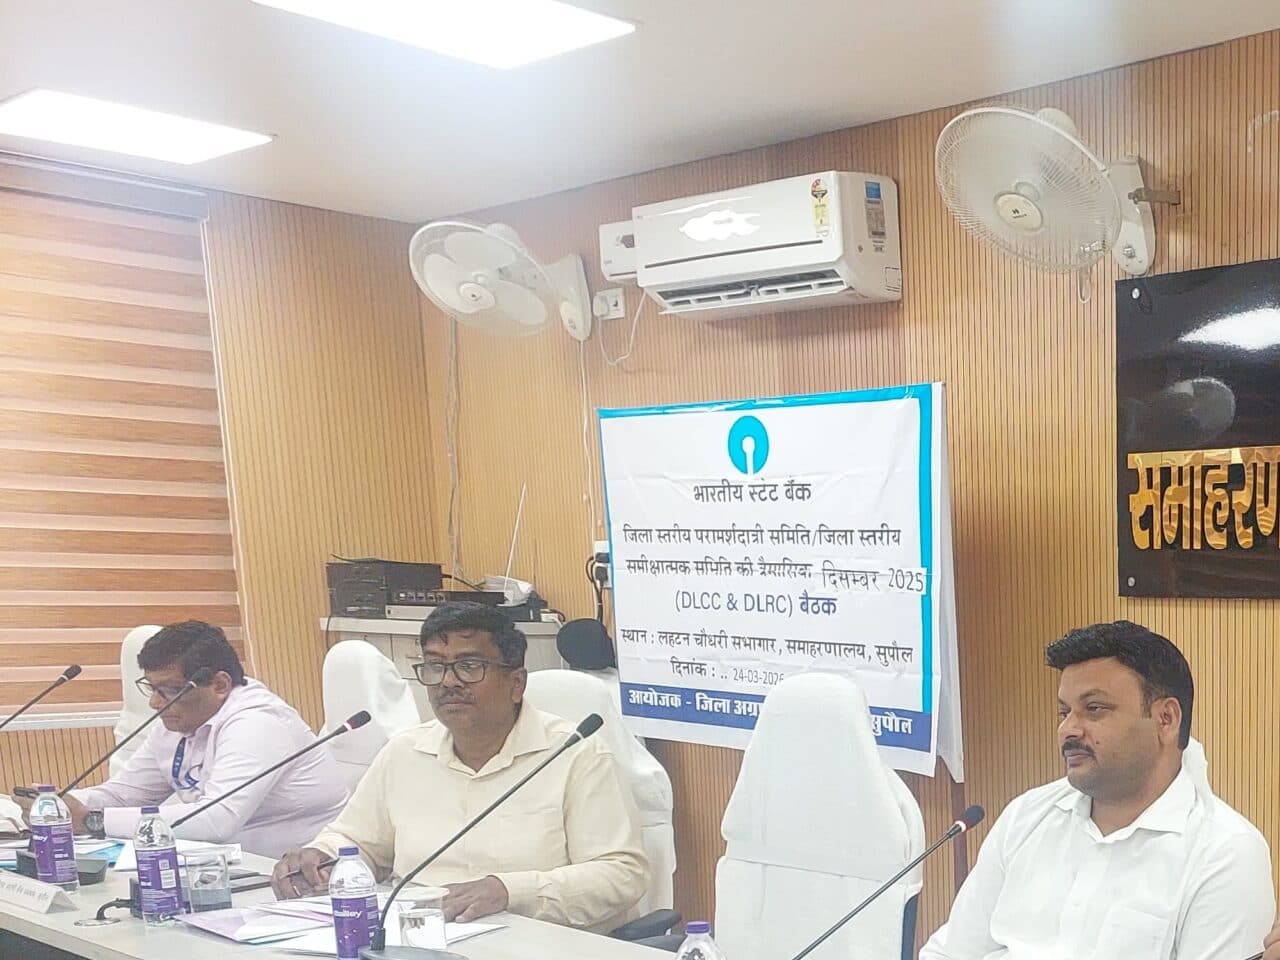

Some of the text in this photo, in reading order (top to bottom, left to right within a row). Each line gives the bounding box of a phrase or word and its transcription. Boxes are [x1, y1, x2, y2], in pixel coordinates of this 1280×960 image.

[693, 478, 744, 502] भारतीय
[623, 523, 653, 543] जिला
[655, 523, 691, 544] स्तरीय
[694, 522, 765, 547] परामर्शदात्री
[858, 522, 902, 546] स्तरीय
[625, 553, 691, 577] समीक्षात्मक
[692, 555, 733, 577] समिति
[734, 556, 754, 577] की
[888, 567, 925, 593] 2025
[675, 590, 838, 618] (DLCC & DLRC) बैठक
[620, 628, 648, 645] स्थान
[657, 630, 692, 648] लहटन
[692, 627, 729, 650] चौधरी
[784, 638, 872, 661] समाहरणालय,
[873, 640, 914, 667] सुपौल
[670, 656, 707, 677] दिनांक
[627, 687, 682, 709] आयोजक
[694, 692, 732, 715] जिला
[733, 700, 761, 718] अग्र
